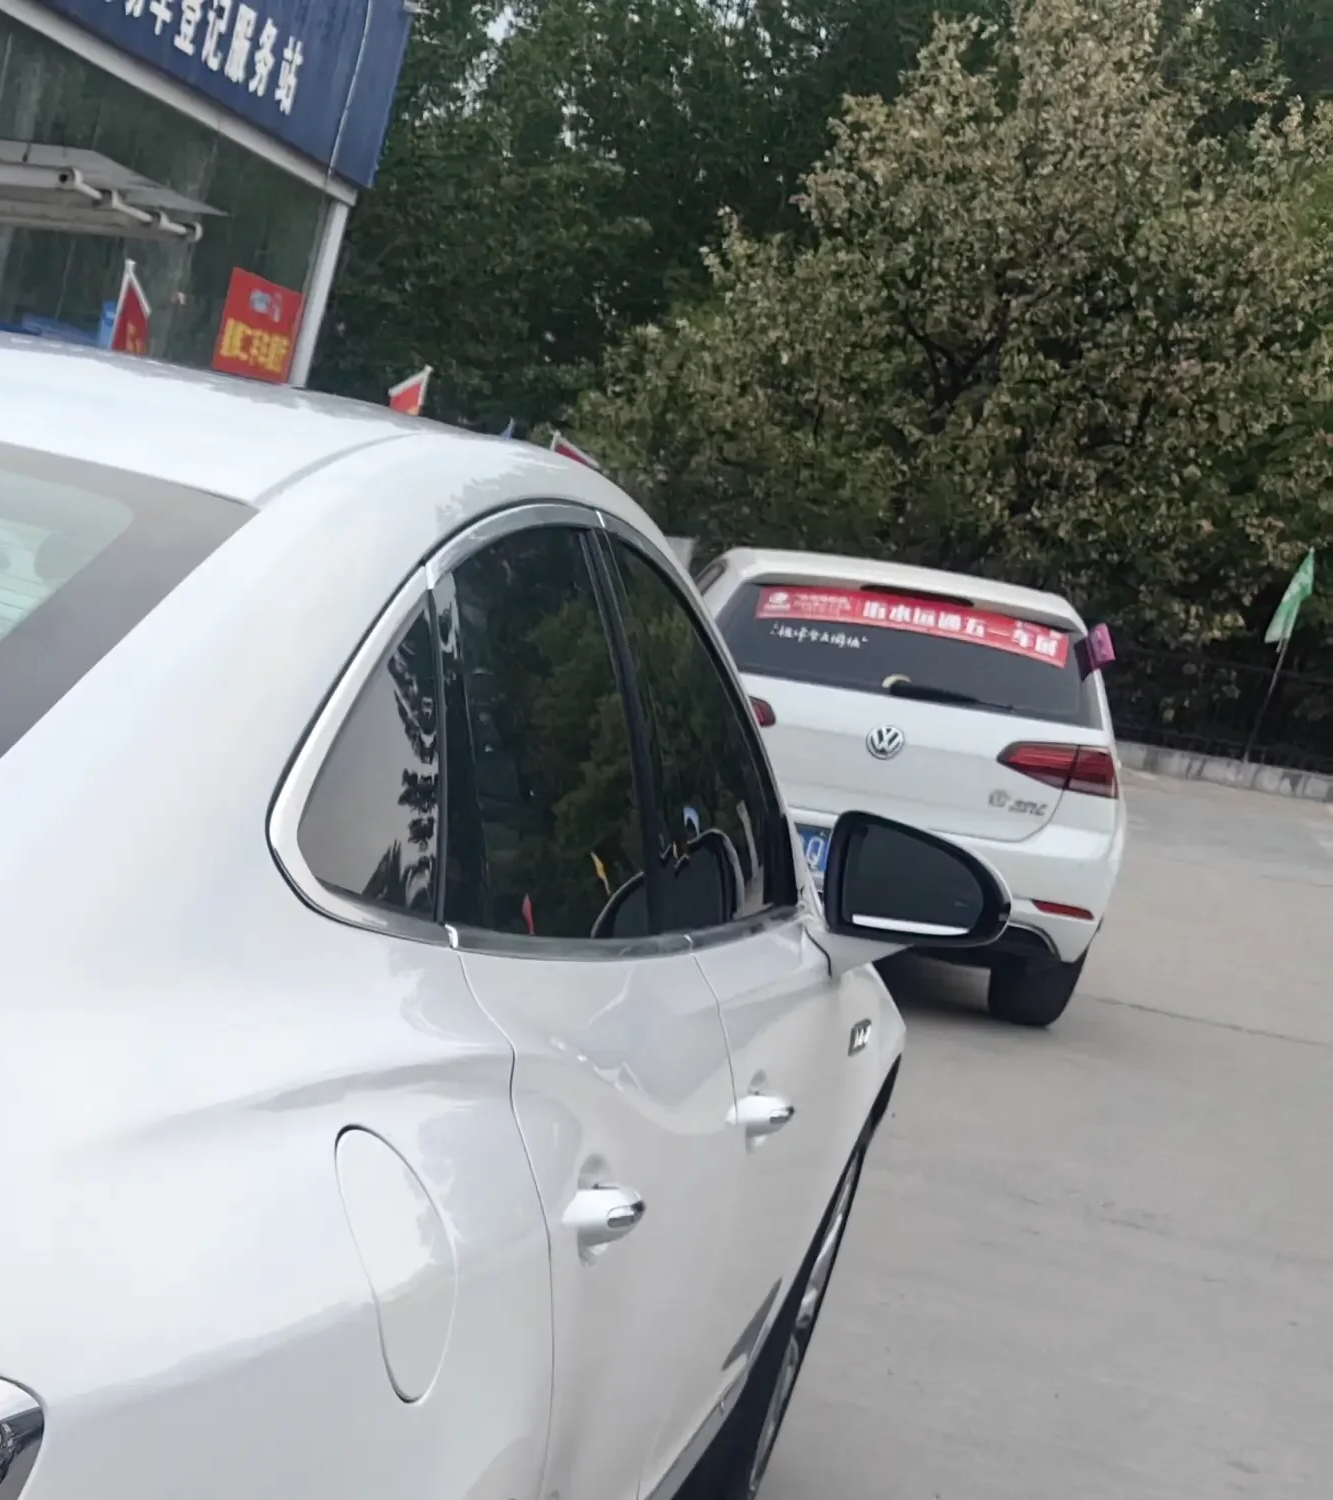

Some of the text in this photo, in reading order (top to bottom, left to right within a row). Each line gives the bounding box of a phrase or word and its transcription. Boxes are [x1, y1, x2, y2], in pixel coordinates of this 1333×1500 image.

[123, 0, 304, 116] 登记服务站
